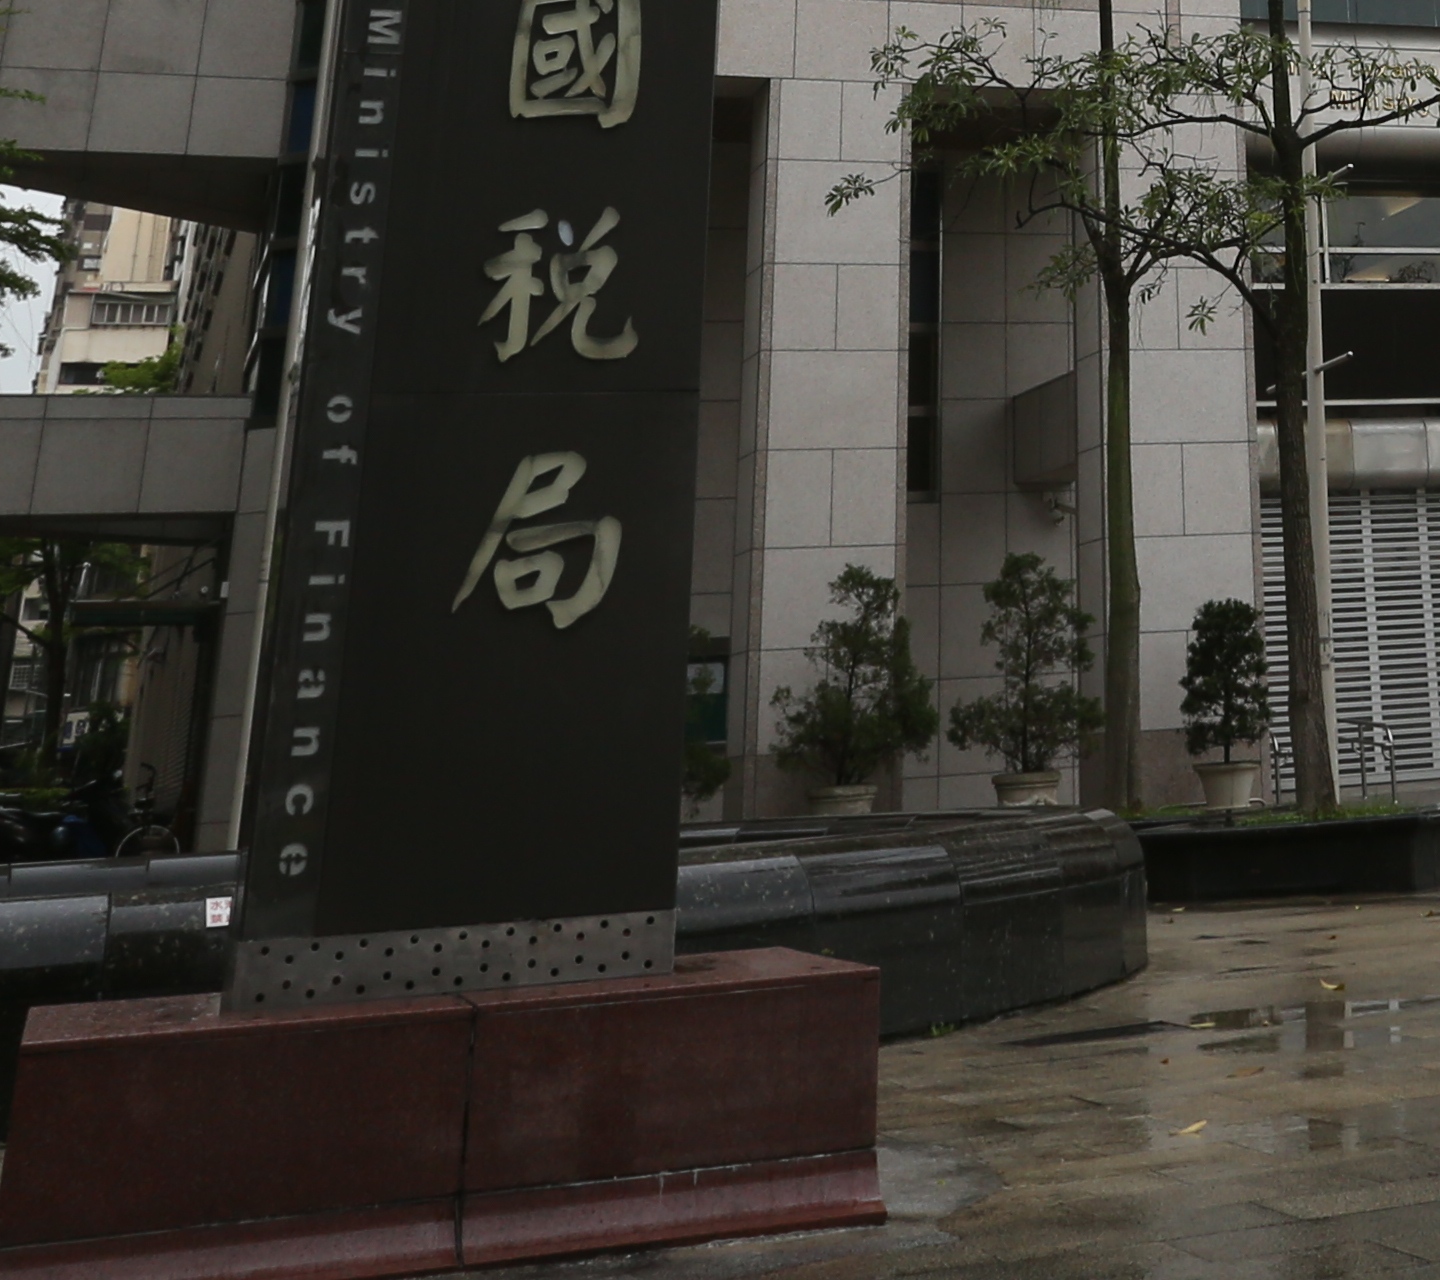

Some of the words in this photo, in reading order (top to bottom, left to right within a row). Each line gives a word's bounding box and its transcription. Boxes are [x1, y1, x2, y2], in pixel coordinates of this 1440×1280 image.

[327, 8, 403, 337] Ministry
[321, 393, 358, 466] of
[278, 518, 352, 878] Finance
